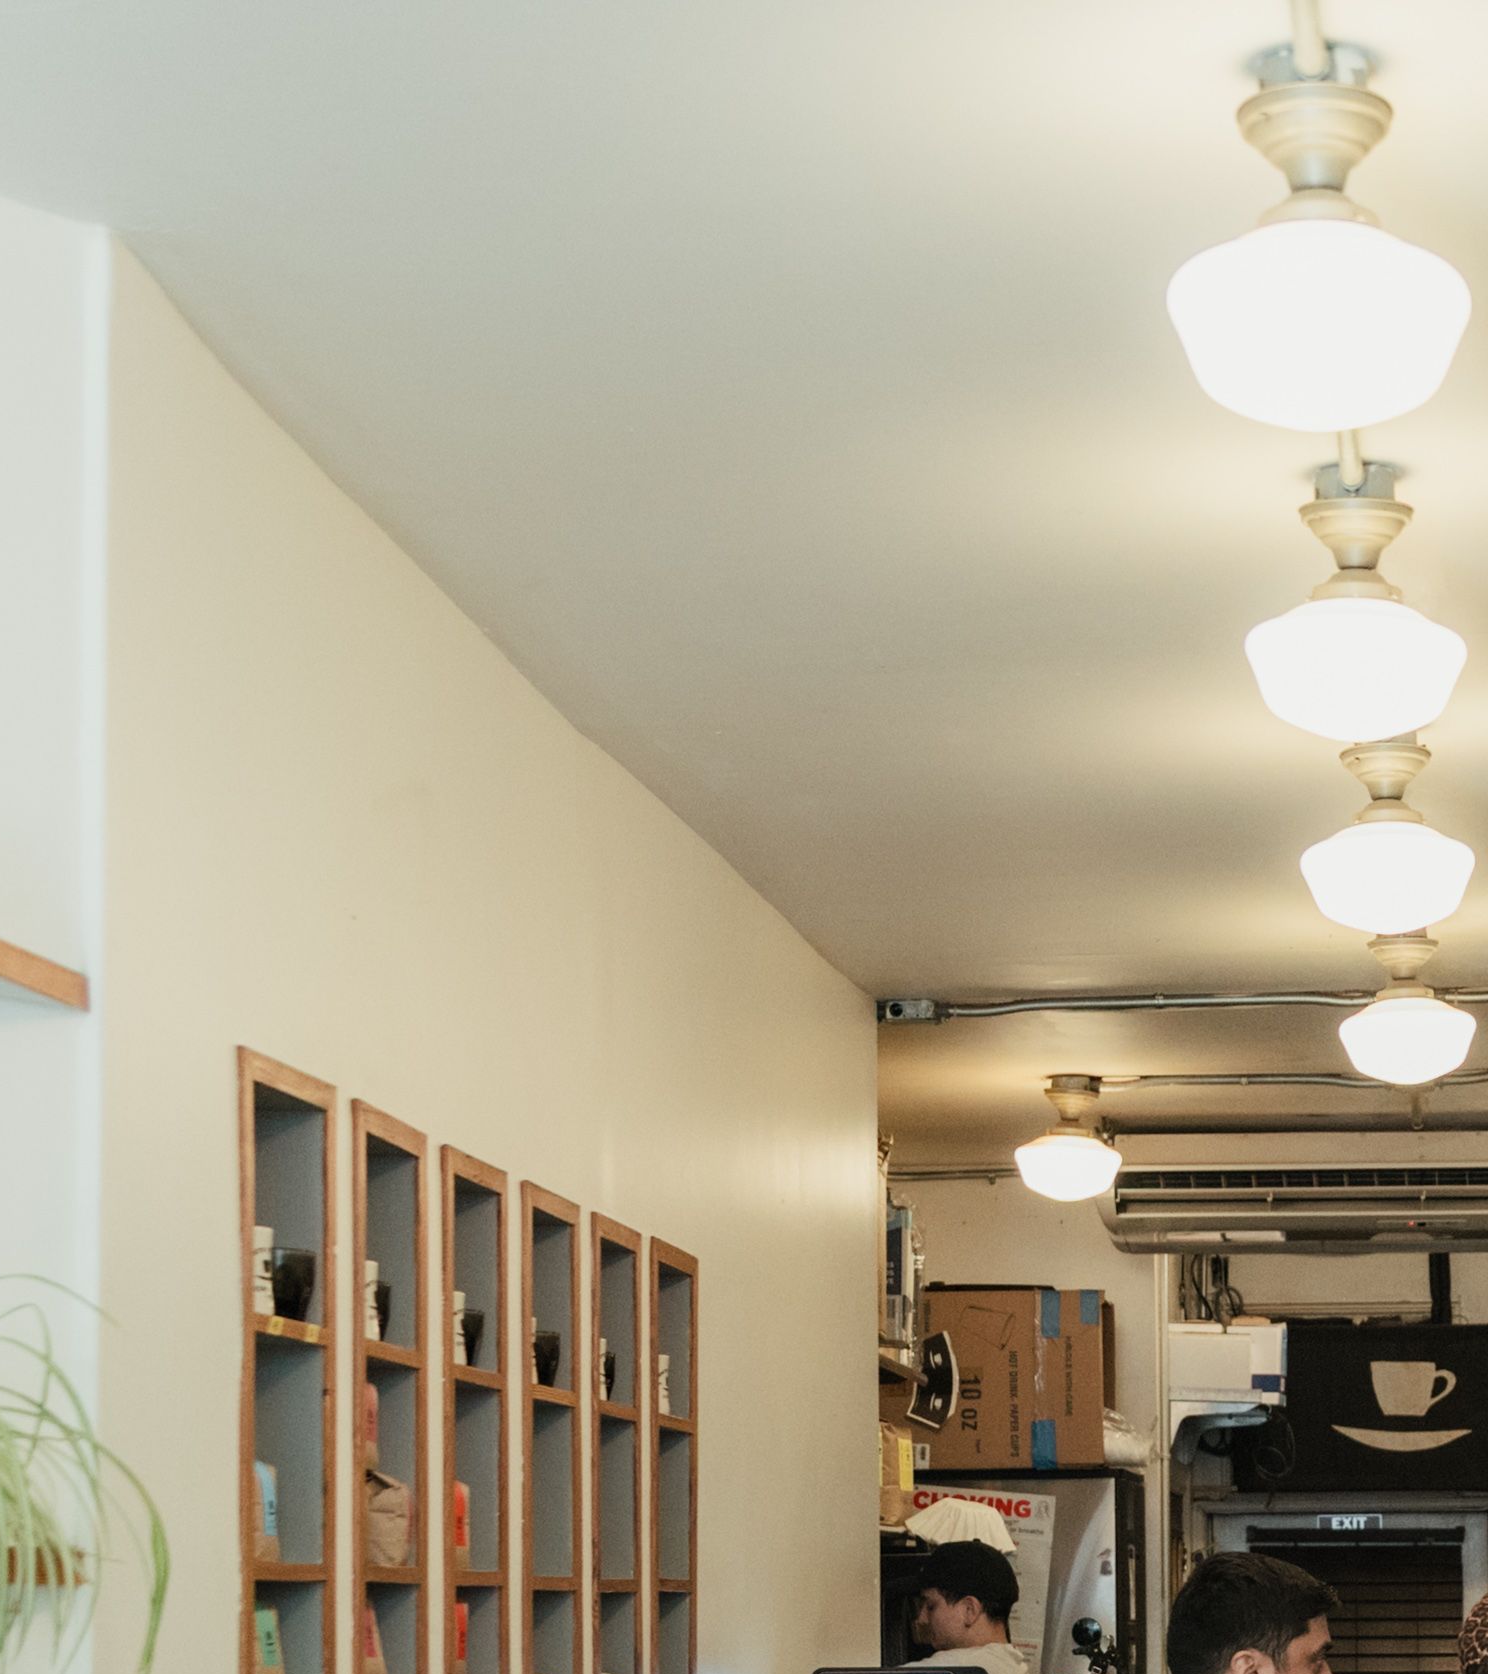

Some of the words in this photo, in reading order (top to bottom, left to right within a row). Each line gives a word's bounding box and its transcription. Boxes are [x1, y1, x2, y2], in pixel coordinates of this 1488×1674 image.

[1009, 1351, 1018, 1368] HOT
[961, 1376, 981, 1400] 10
[962, 1408, 978, 1431] OZ
[1010, 1403, 1019, 1431] PAPER
[1010, 1434, 1020, 1457] CUPS
[913, 1490, 1032, 1518] CING
[1332, 1516, 1367, 1530] EXIT
